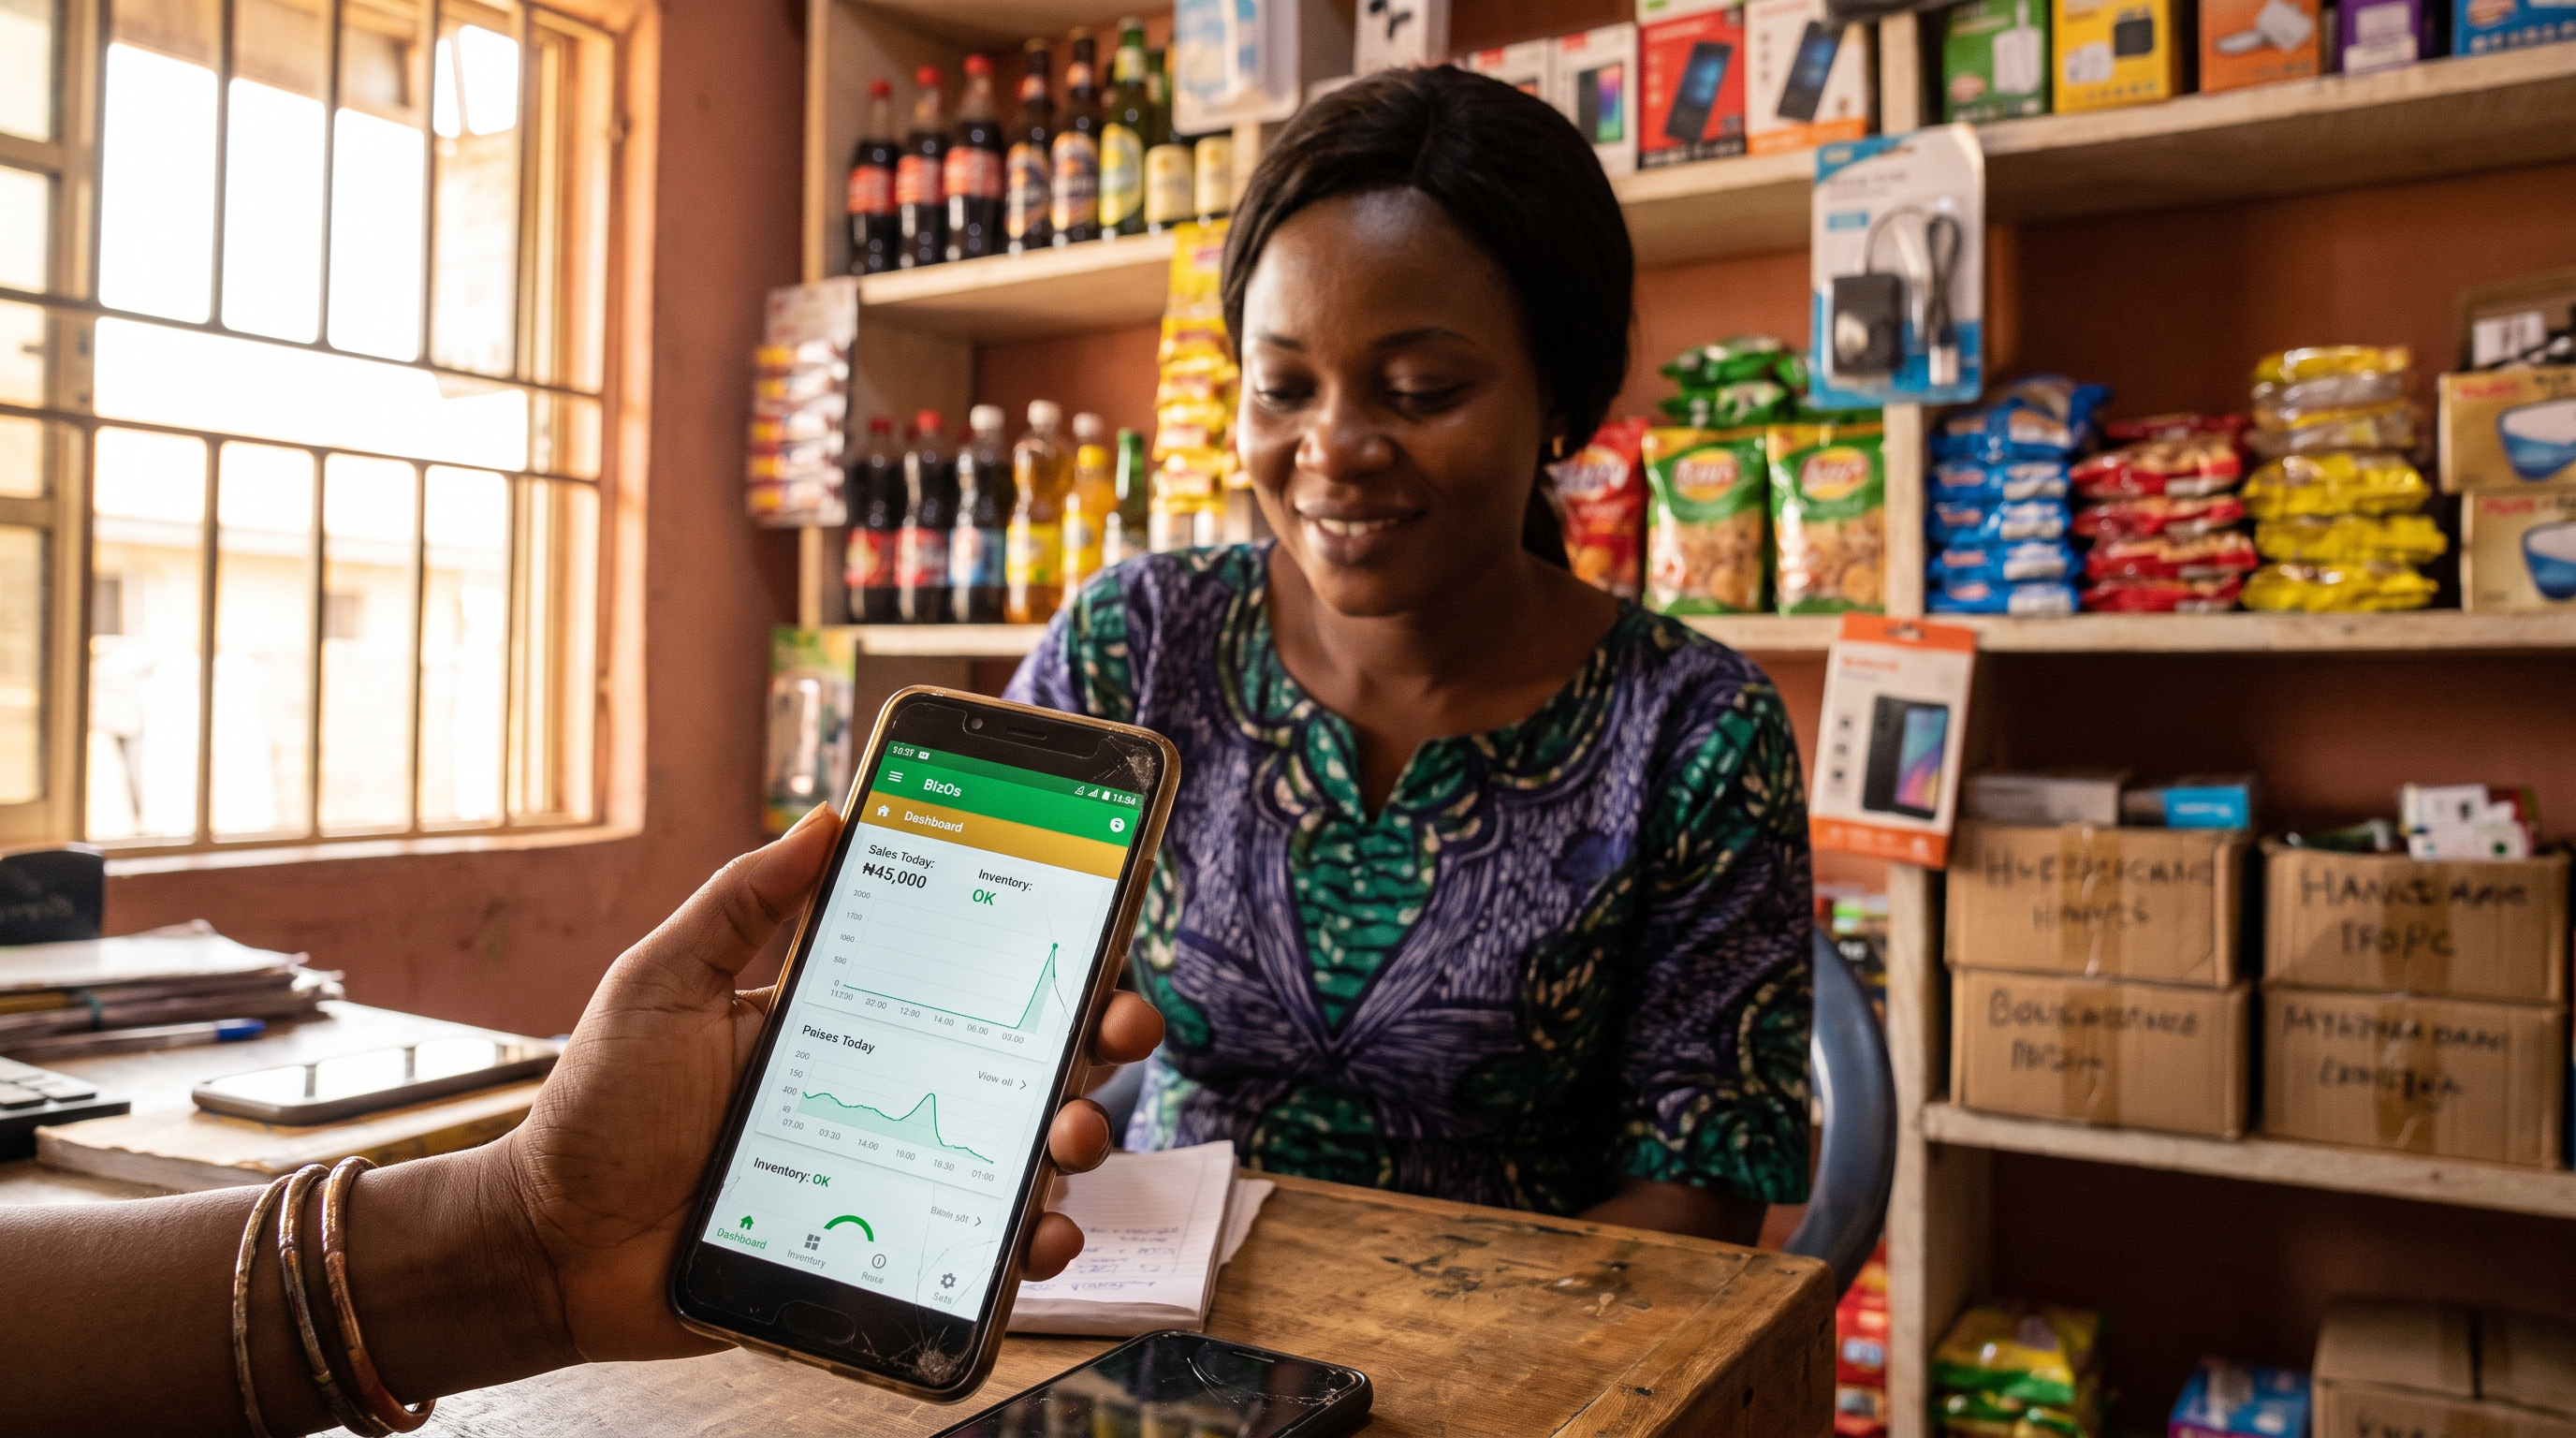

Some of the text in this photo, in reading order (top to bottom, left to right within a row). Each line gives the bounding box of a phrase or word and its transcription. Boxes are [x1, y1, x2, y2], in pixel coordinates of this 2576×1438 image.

[868, 844, 935, 869] Sales Today:
[978, 869, 1032, 891] Inventory:
[854, 889, 871, 900] 2000
[973, 889, 997, 906] OK
[843, 1035, 874, 1054] Today
[796, 1050, 811, 1061] 200
[754, 1157, 831, 1188] Inventory: OK
[716, 1227, 768, 1250] Dashboard
[786, 1249, 827, 1269] Inventory
